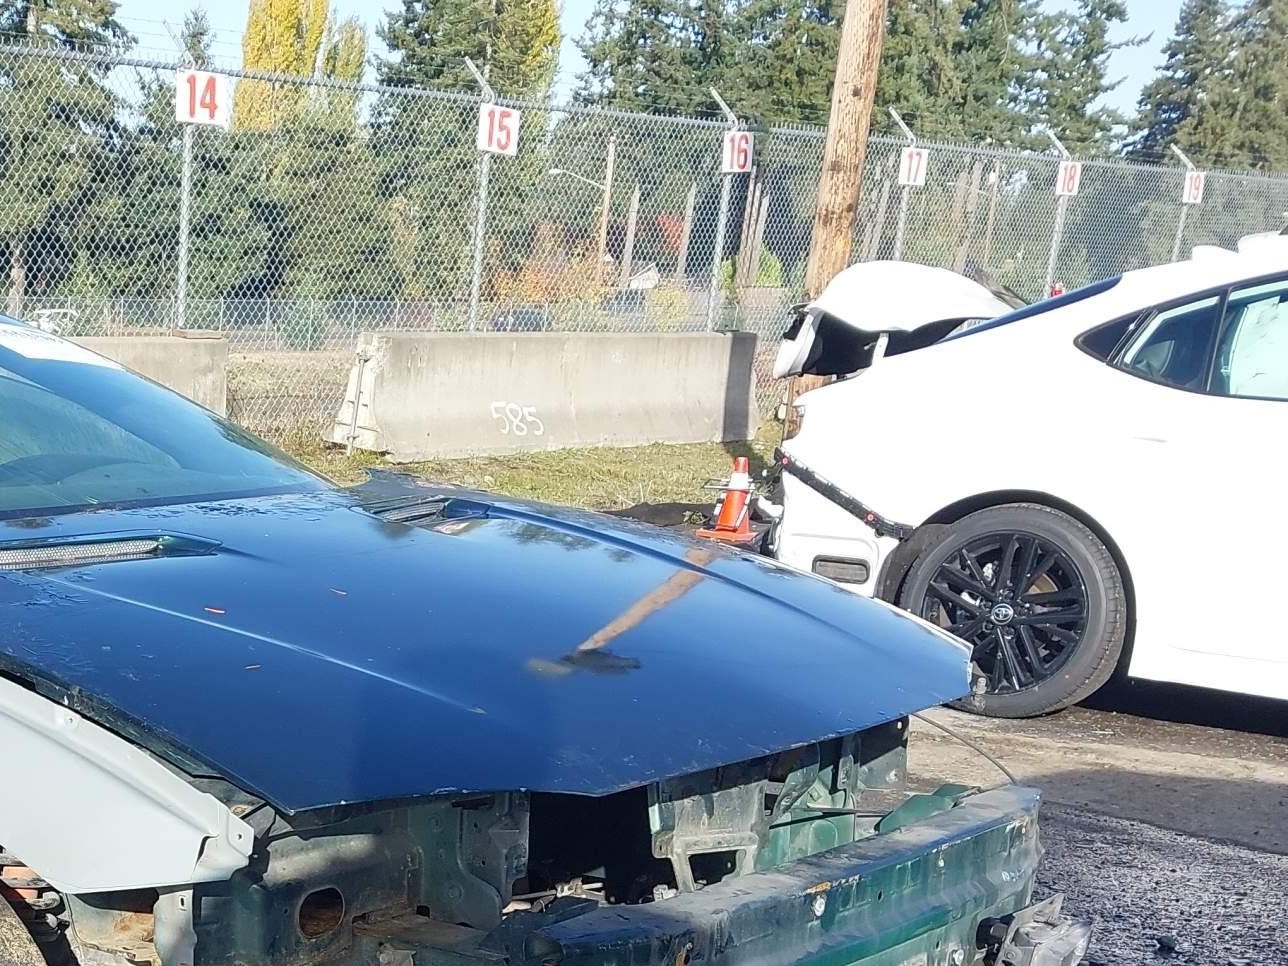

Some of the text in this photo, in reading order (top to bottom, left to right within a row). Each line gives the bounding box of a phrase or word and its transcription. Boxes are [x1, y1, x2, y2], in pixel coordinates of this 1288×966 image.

[187, 74, 218, 119] 14
[488, 110, 512, 151] 15
[729, 133, 749, 170] 16
[907, 151, 922, 183] 17
[1061, 163, 1078, 193] 18
[1187, 174, 1201, 201] 19
[491, 401, 544, 436] 585
